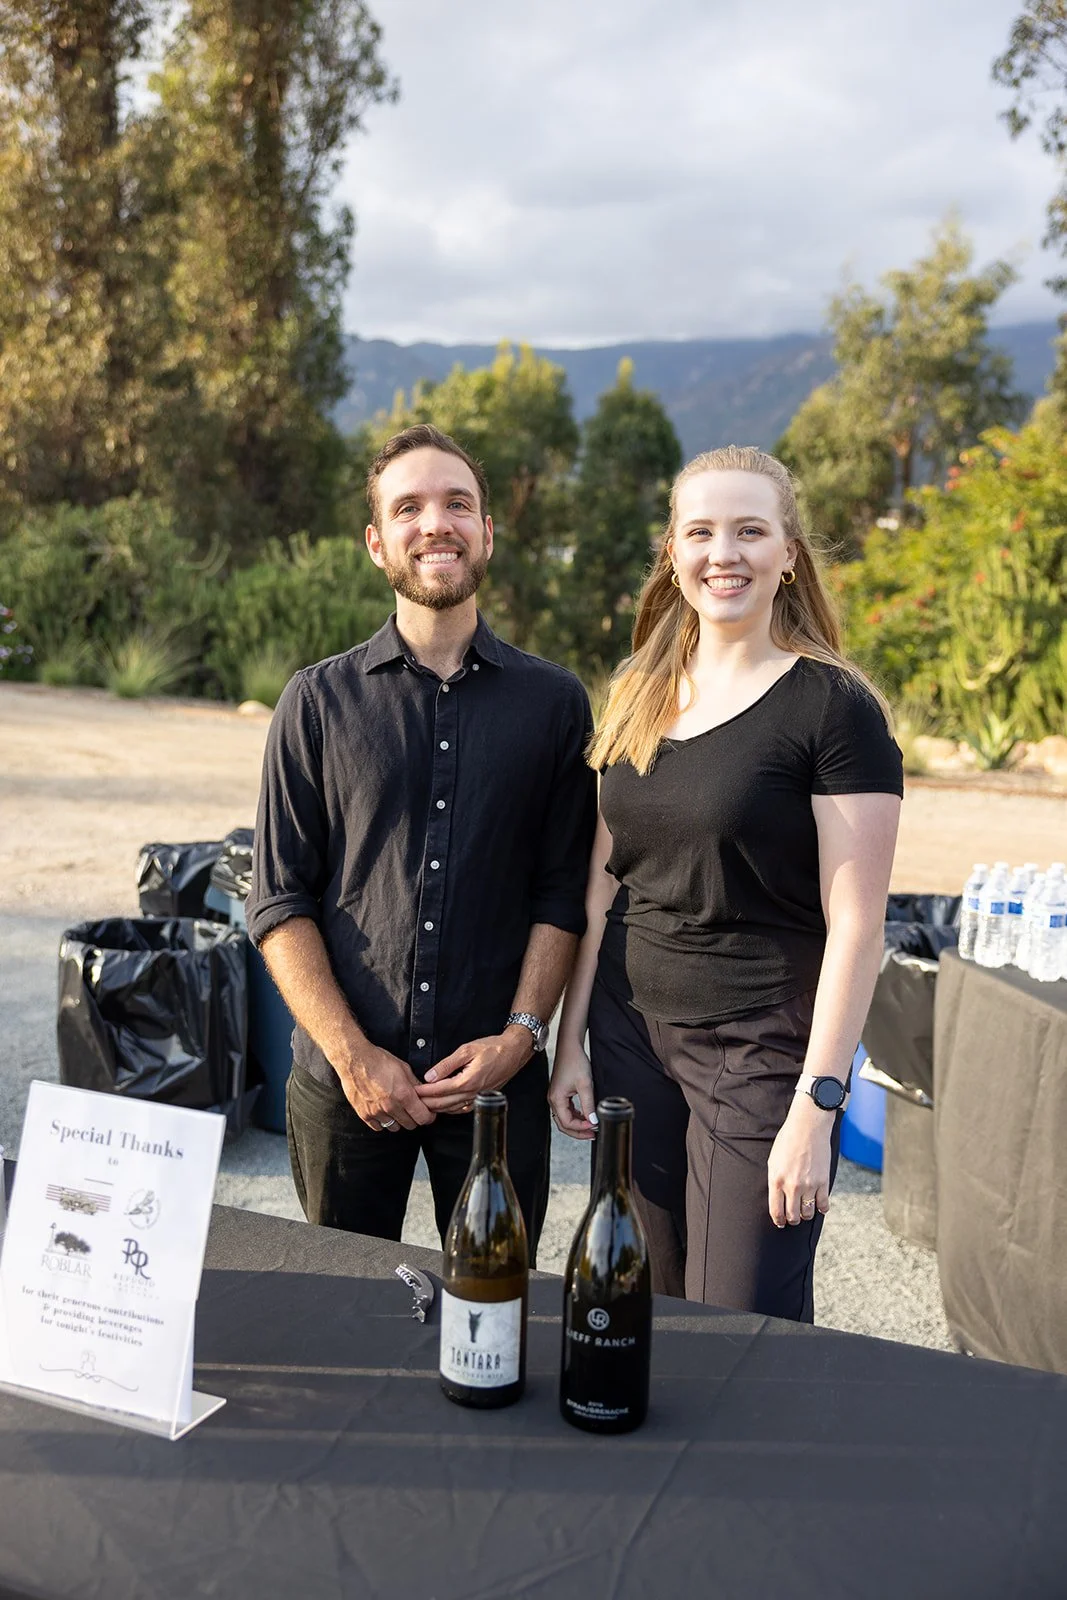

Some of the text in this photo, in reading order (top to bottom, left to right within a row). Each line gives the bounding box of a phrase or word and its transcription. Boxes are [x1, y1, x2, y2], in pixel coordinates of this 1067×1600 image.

[50, 1118, 185, 1160] Special Thanks
[107, 1157, 119, 1166] to
[40, 1253, 93, 1279] ROBLAR
[22, 1285, 165, 1326] for their generous contributions
[40, 1315, 53, 1325] for
[98, 1329, 143, 1347] festivities
[53, 1307, 95, 1324] providing
[98, 1316, 143, 1334] beverages
[594, 1336, 636, 1347] RANCH
[451, 1346, 501, 1370] TANTARA
